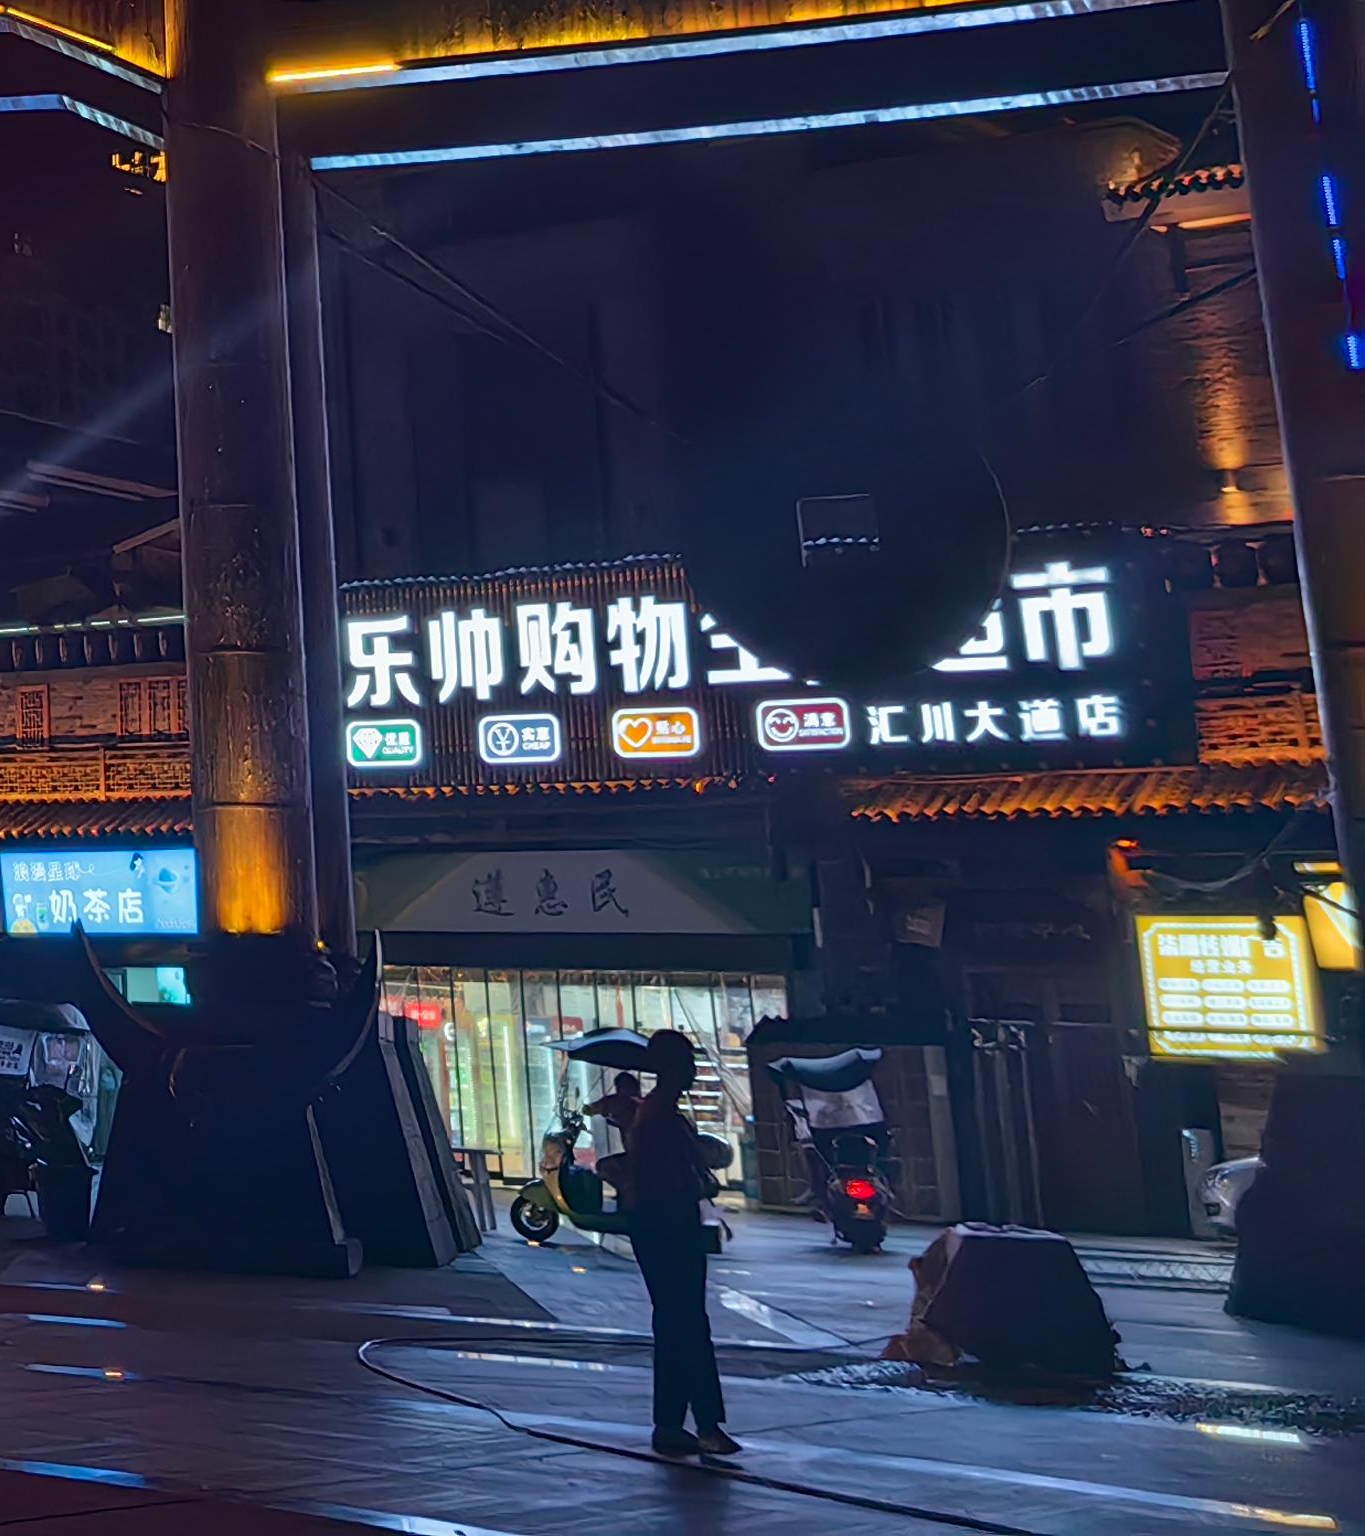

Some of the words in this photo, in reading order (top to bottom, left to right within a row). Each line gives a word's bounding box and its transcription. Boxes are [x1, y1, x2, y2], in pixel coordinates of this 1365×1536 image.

[345, 561, 1117, 710] 乐帅购物市
[868, 692, 1124, 746] 汇川大道店
[49, 888, 144, 923] 奶茶店
[471, 868, 630, 917] 遵惠民
